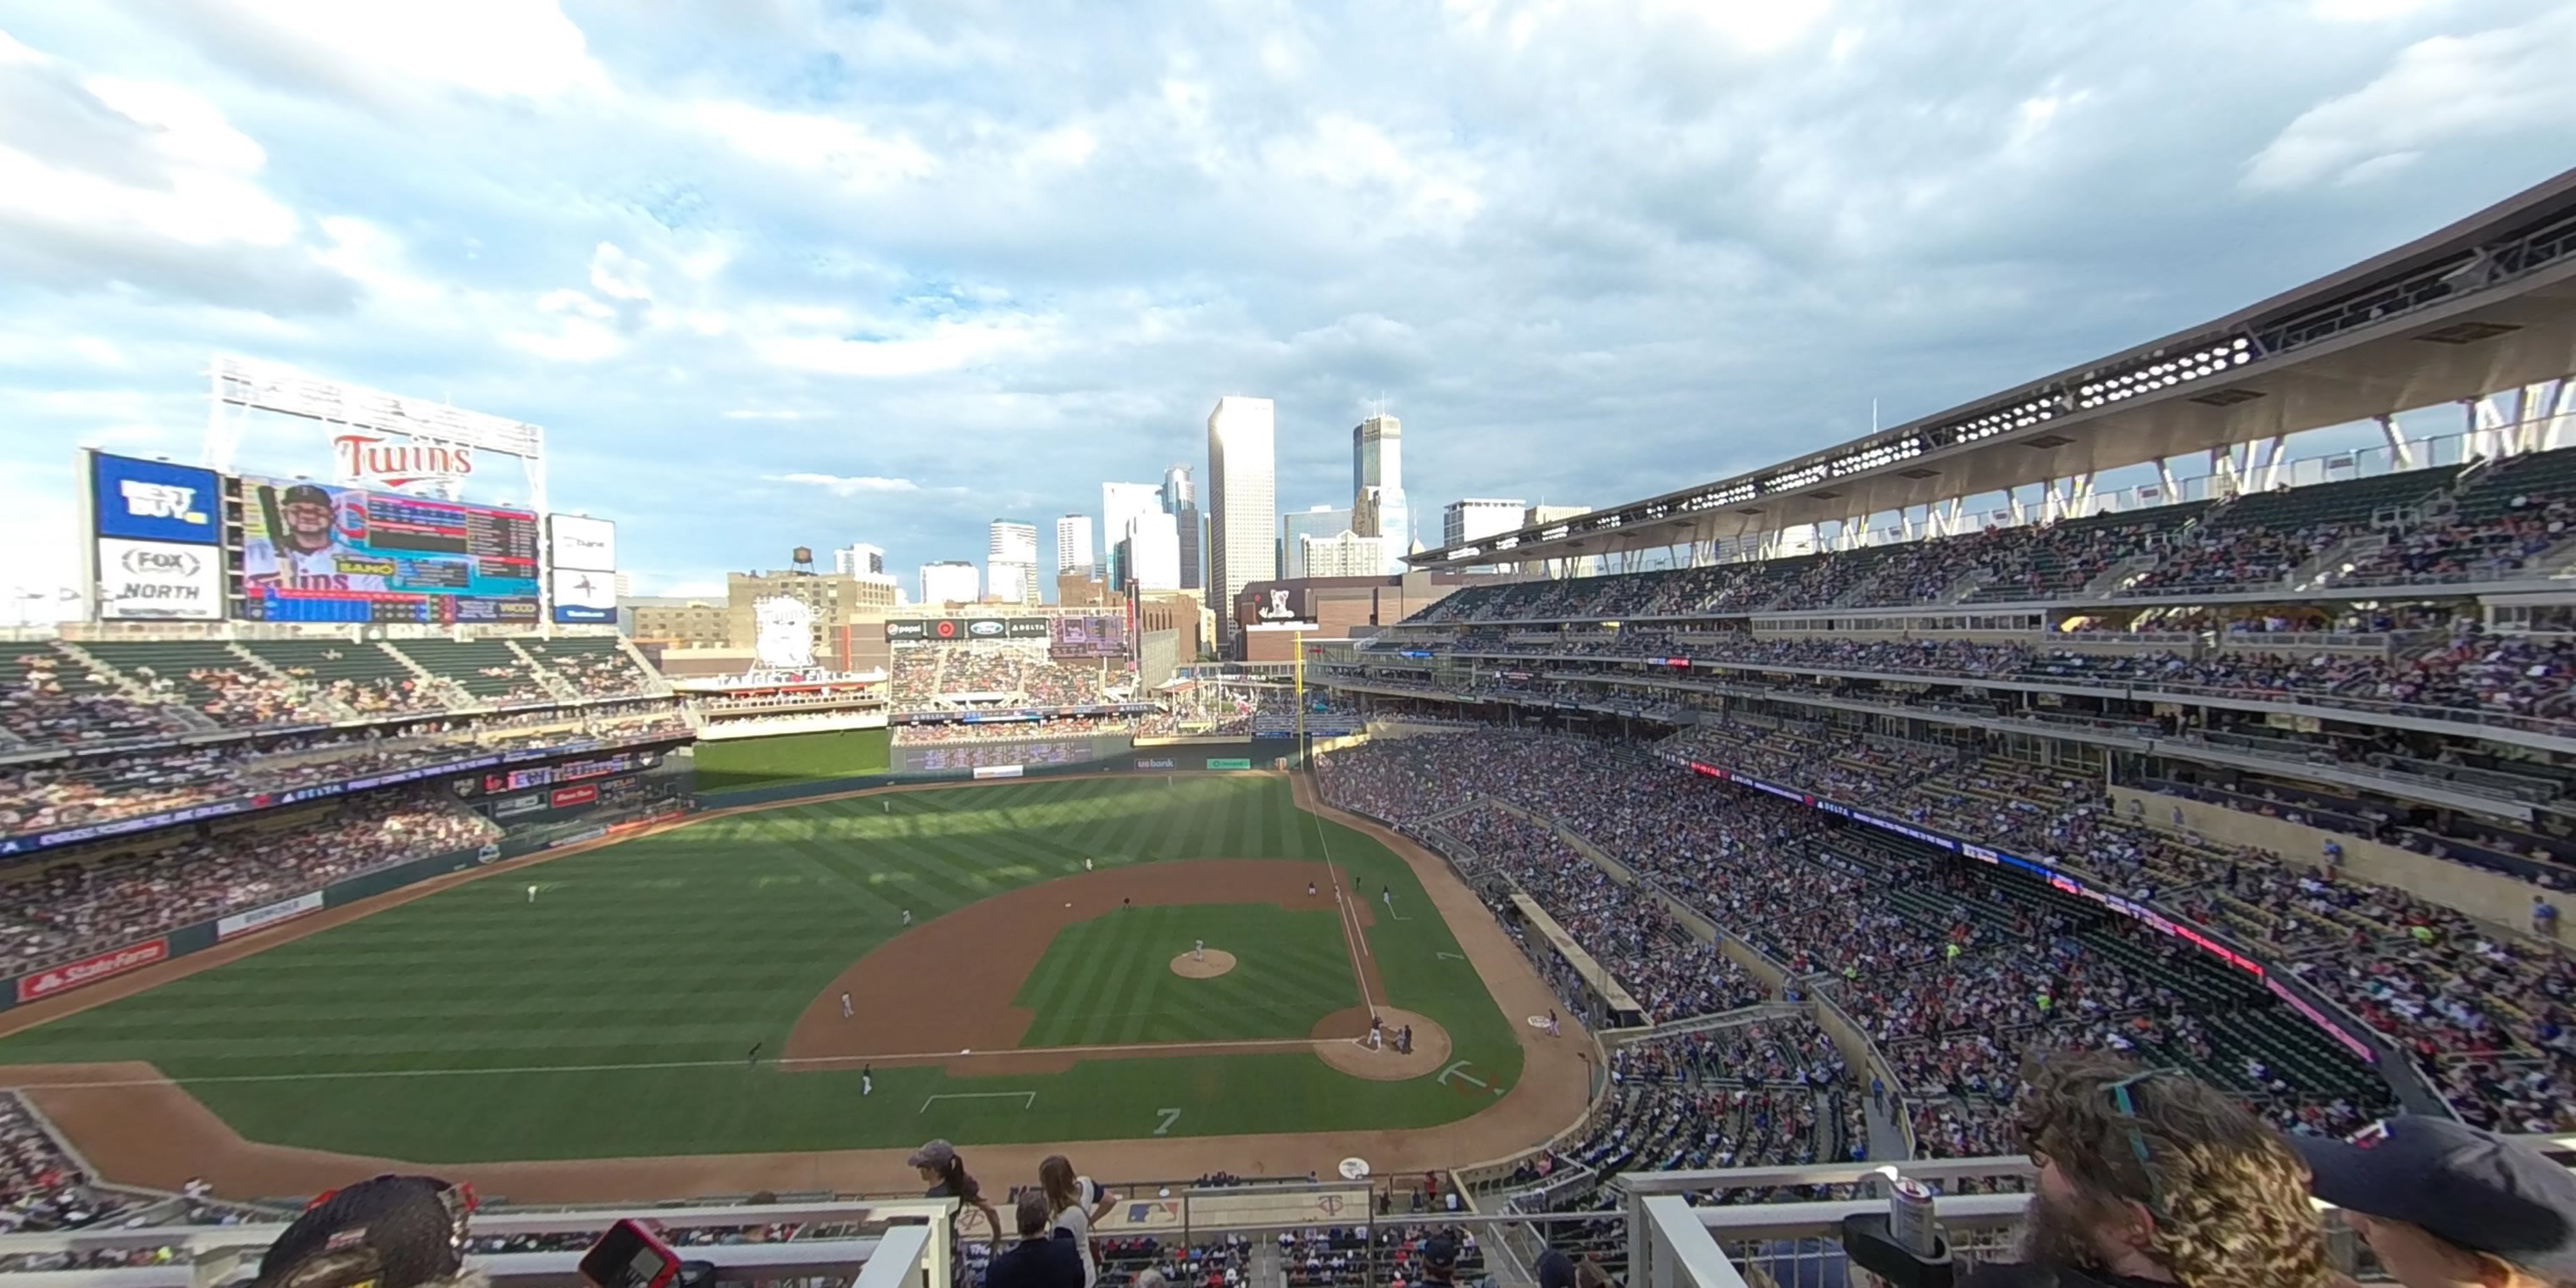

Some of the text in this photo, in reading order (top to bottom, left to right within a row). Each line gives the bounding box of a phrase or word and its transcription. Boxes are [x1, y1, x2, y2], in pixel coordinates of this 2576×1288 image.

[334, 435, 472, 477] Twins
[120, 479, 197, 502] BEST
[128, 496, 191, 520] BUY
[138, 552, 183, 569] FOX
[124, 583, 200, 600] NORTH
[297, 785, 341, 800] DELTA
[1824, 802, 1849, 816] DELTA
[1153, 1108, 1180, 1135] 7
